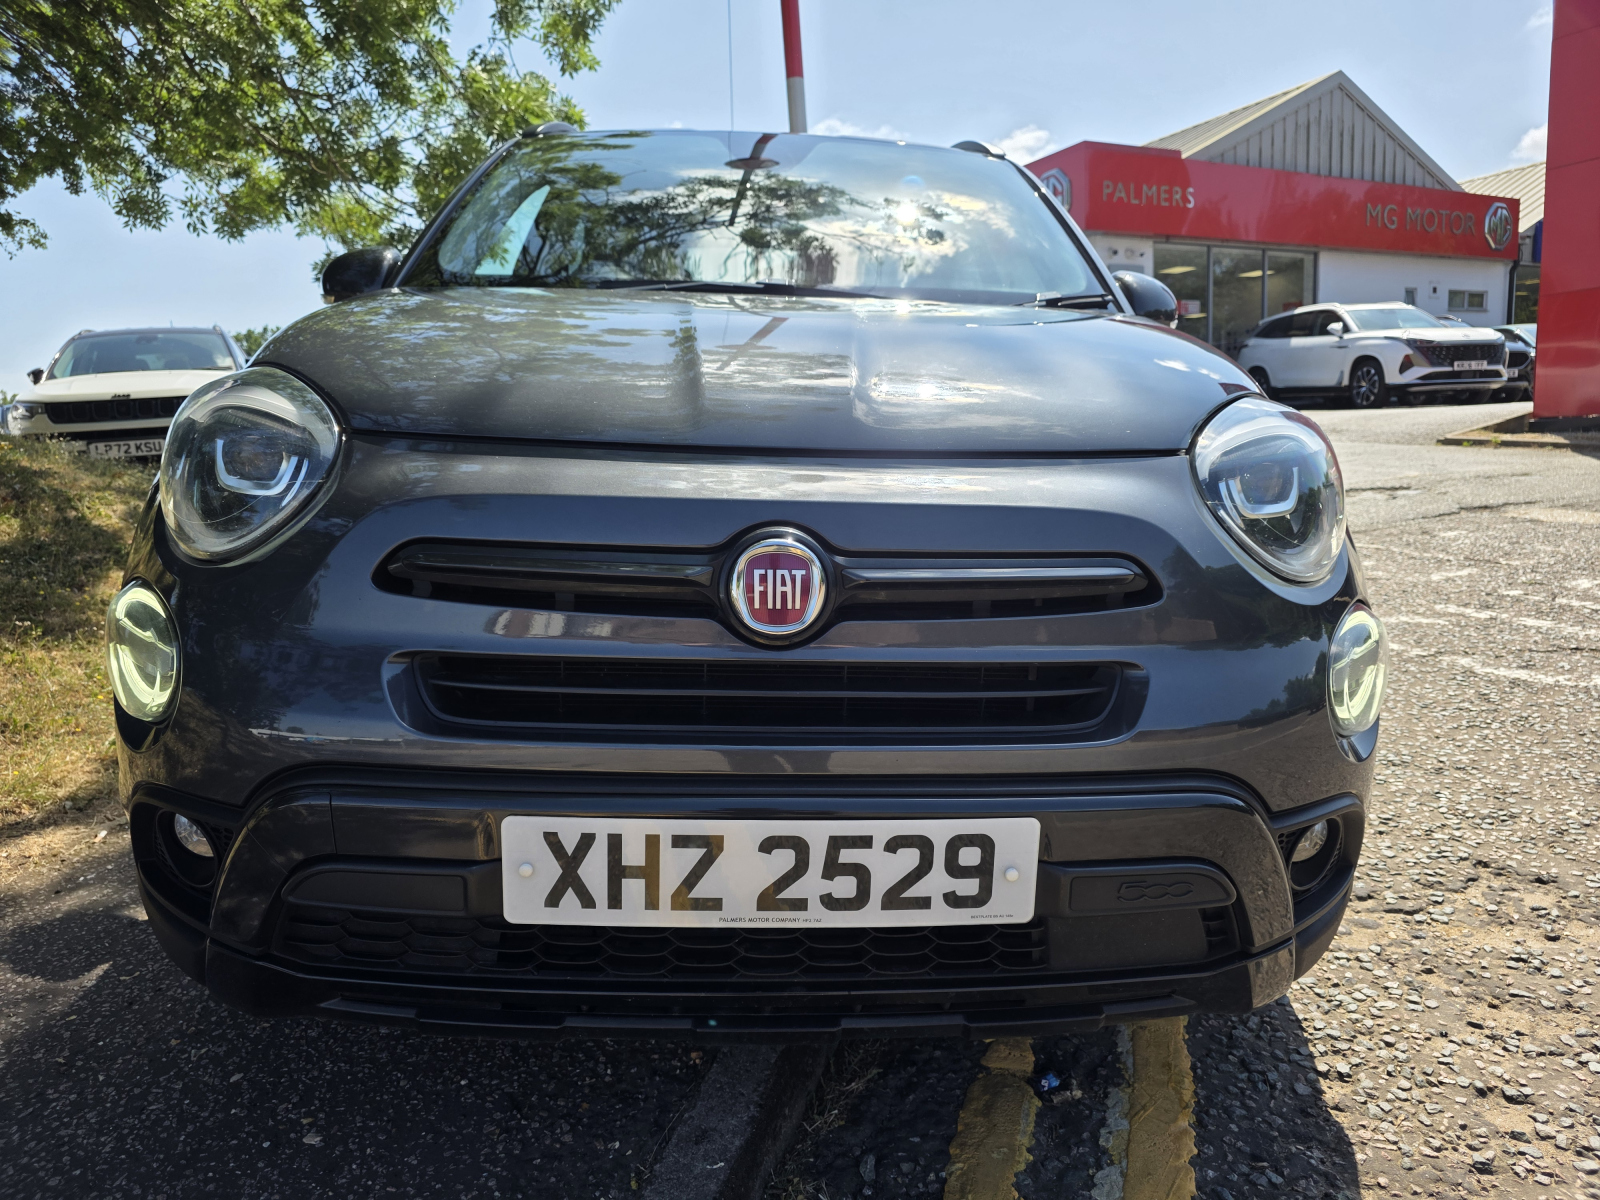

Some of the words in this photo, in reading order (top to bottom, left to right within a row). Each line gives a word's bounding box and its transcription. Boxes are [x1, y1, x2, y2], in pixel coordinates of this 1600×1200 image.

[1102, 180, 1195, 209] PALMERS
[1366, 203, 1398, 230] MG
[1406, 206, 1476, 236] MOTOR
[1489, 207, 1512, 245] MG
[134, 441, 163, 454] KSU
[753, 569, 807, 610] FIAT
[542, 831, 725, 911] XHZ
[756, 833, 996, 912] 2529
